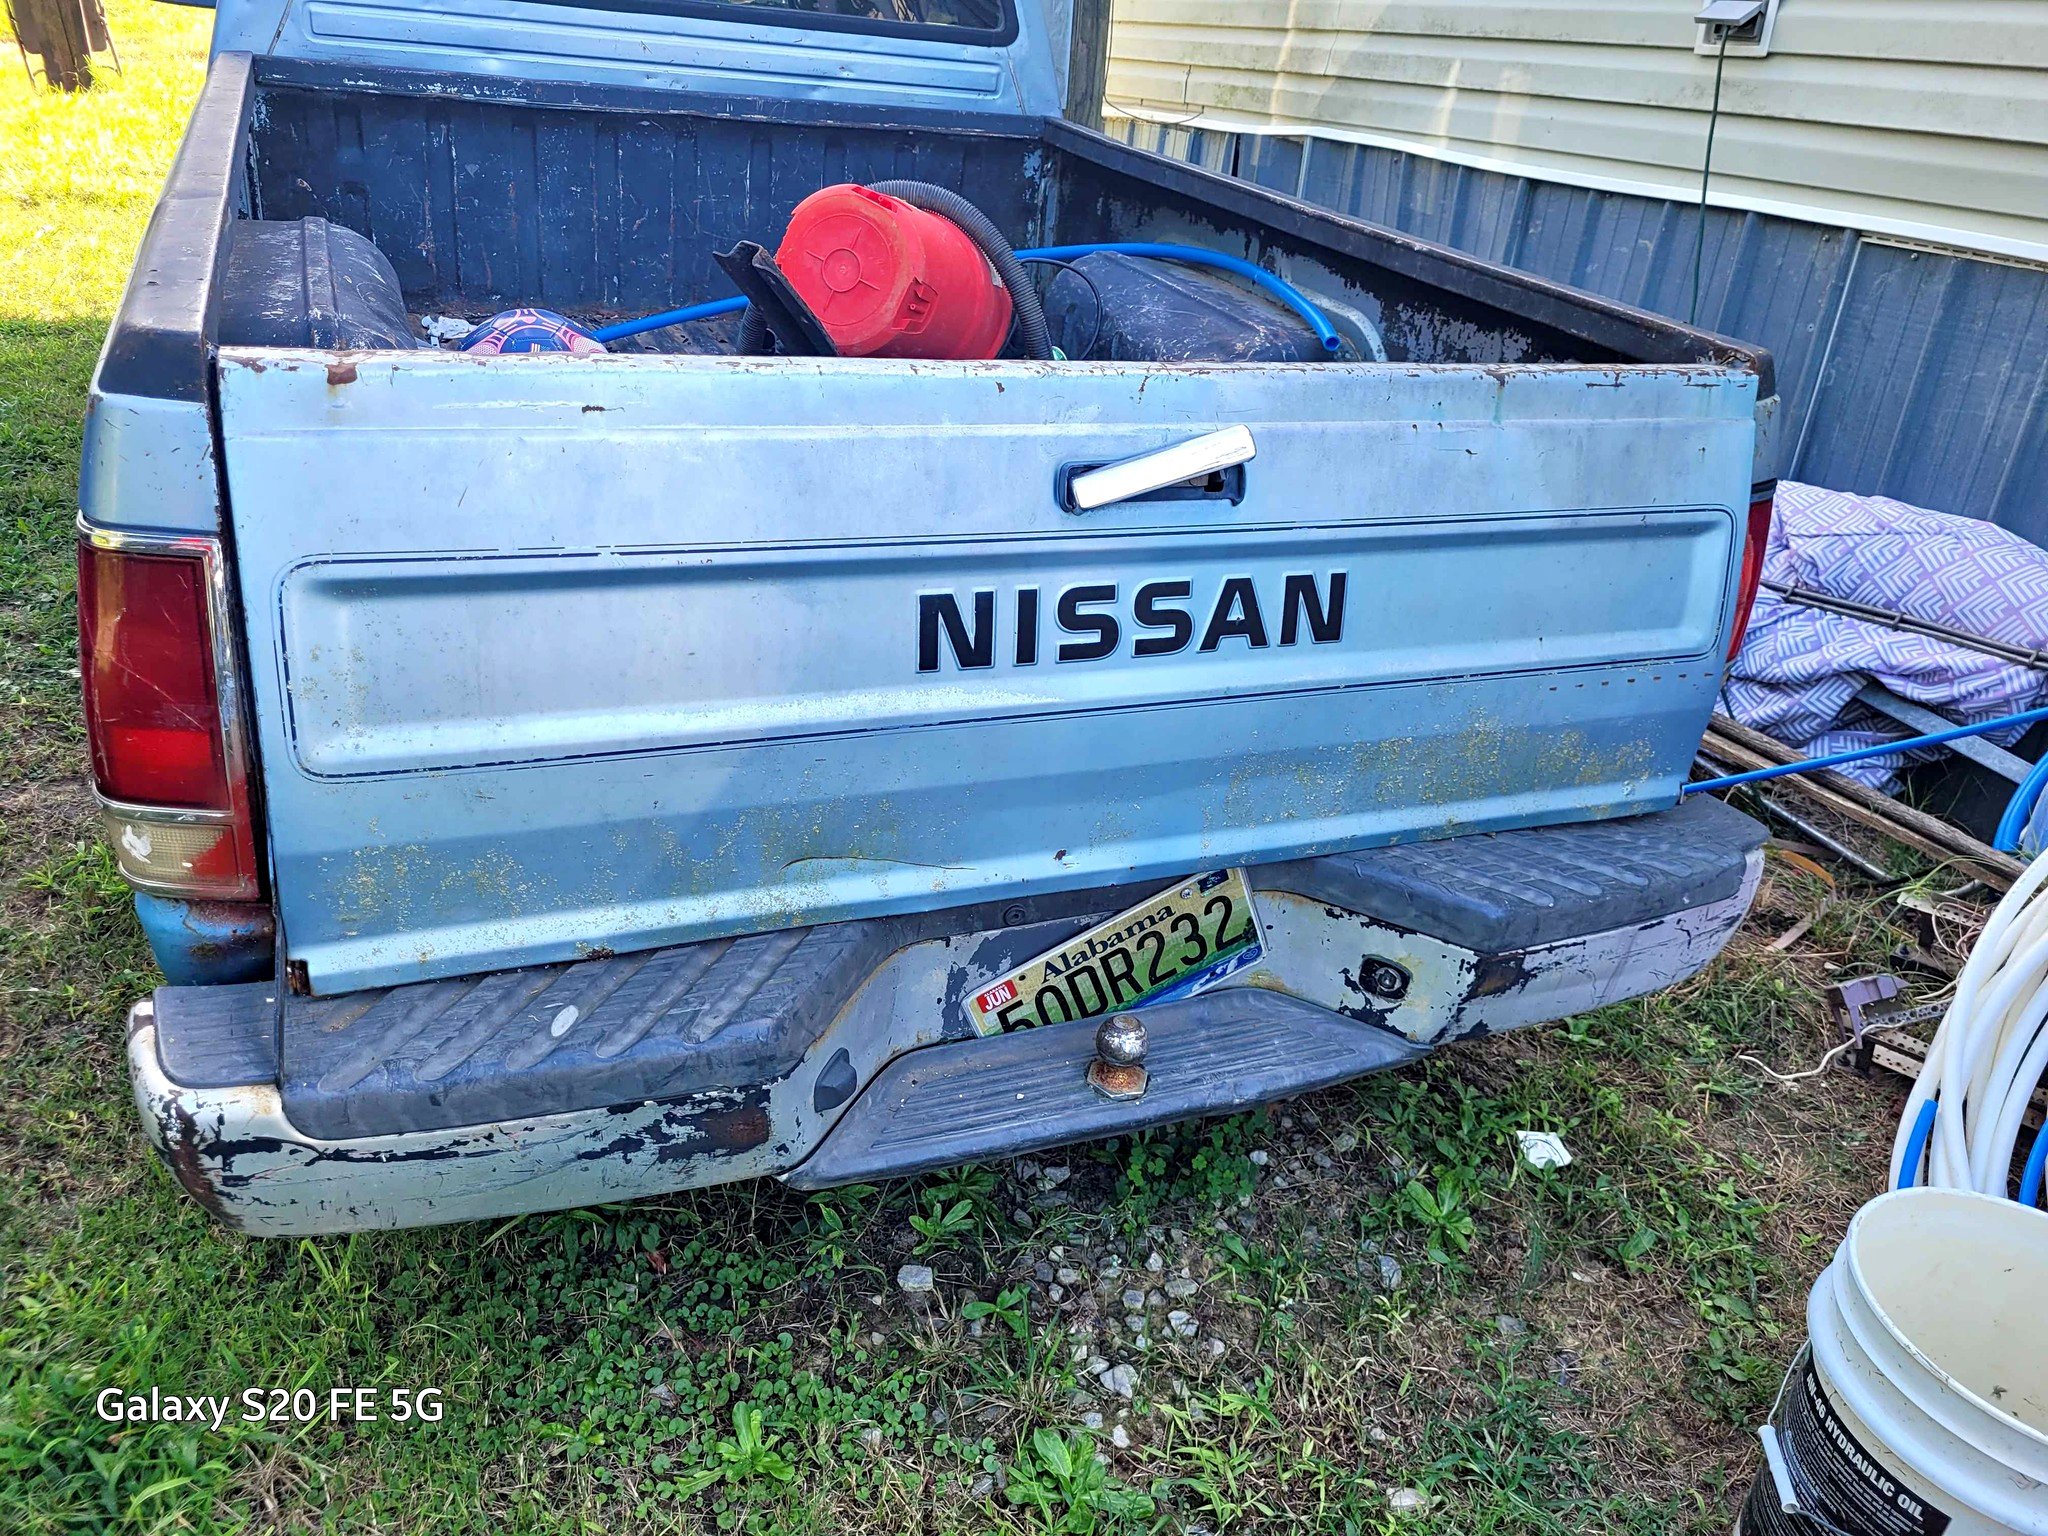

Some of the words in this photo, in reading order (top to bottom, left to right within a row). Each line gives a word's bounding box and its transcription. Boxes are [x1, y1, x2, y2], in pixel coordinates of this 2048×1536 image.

[917, 570, 1349, 673] NISSAN
[1040, 905, 1177, 984] Alabama
[985, 985, 1012, 1011] JUN
[1824, 1415, 1896, 1497] HYDRAULIC
[1896, 1493, 1925, 1522] OIL
